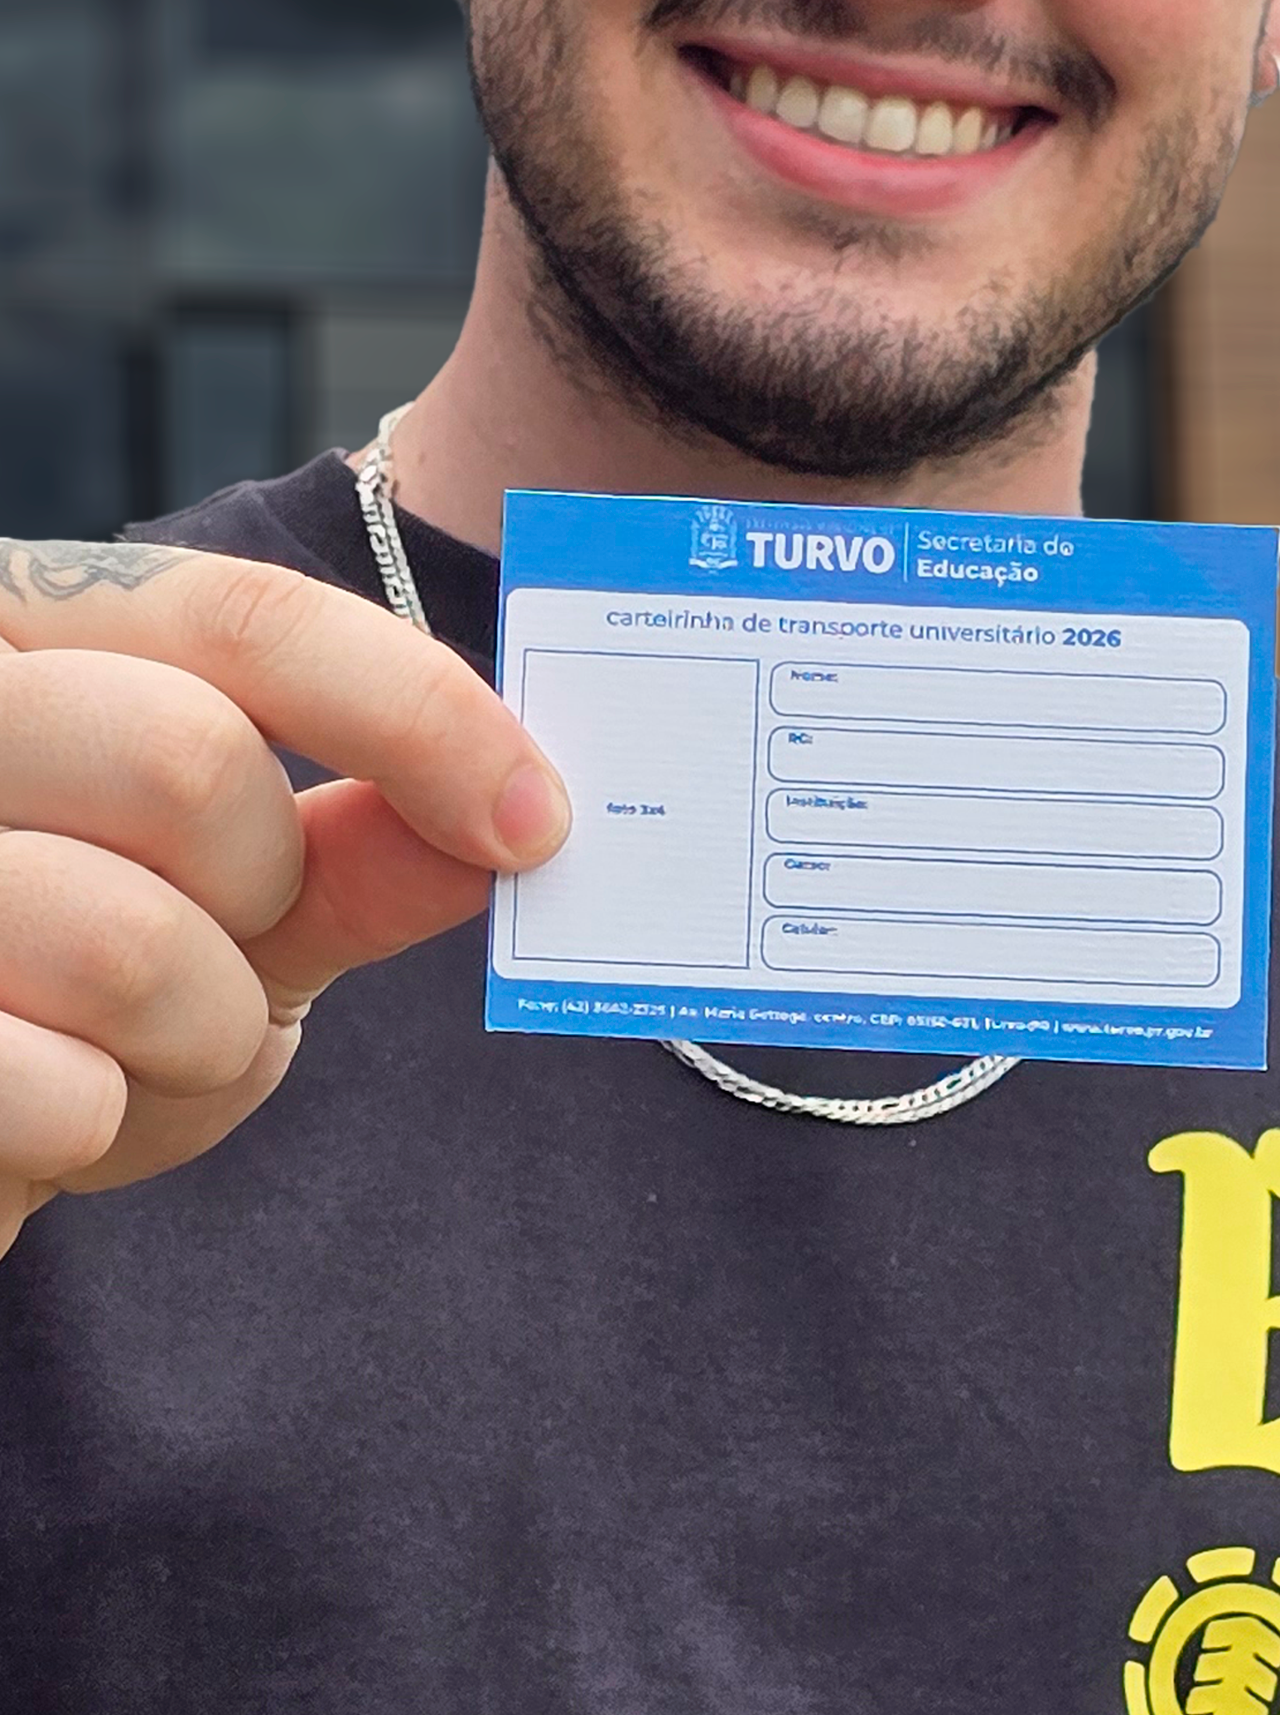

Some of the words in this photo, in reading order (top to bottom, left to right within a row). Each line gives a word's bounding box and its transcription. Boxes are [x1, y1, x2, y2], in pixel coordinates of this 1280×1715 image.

[746, 532, 895, 574] TURVO
[917, 529, 1036, 555] Secretaria
[917, 559, 1038, 586] Educação
[606, 609, 734, 631] carteirinha
[742, 612, 772, 633] de
[779, 616, 903, 639] transporte
[910, 623, 1056, 645] universitário
[1062, 627, 1122, 648] 2026
